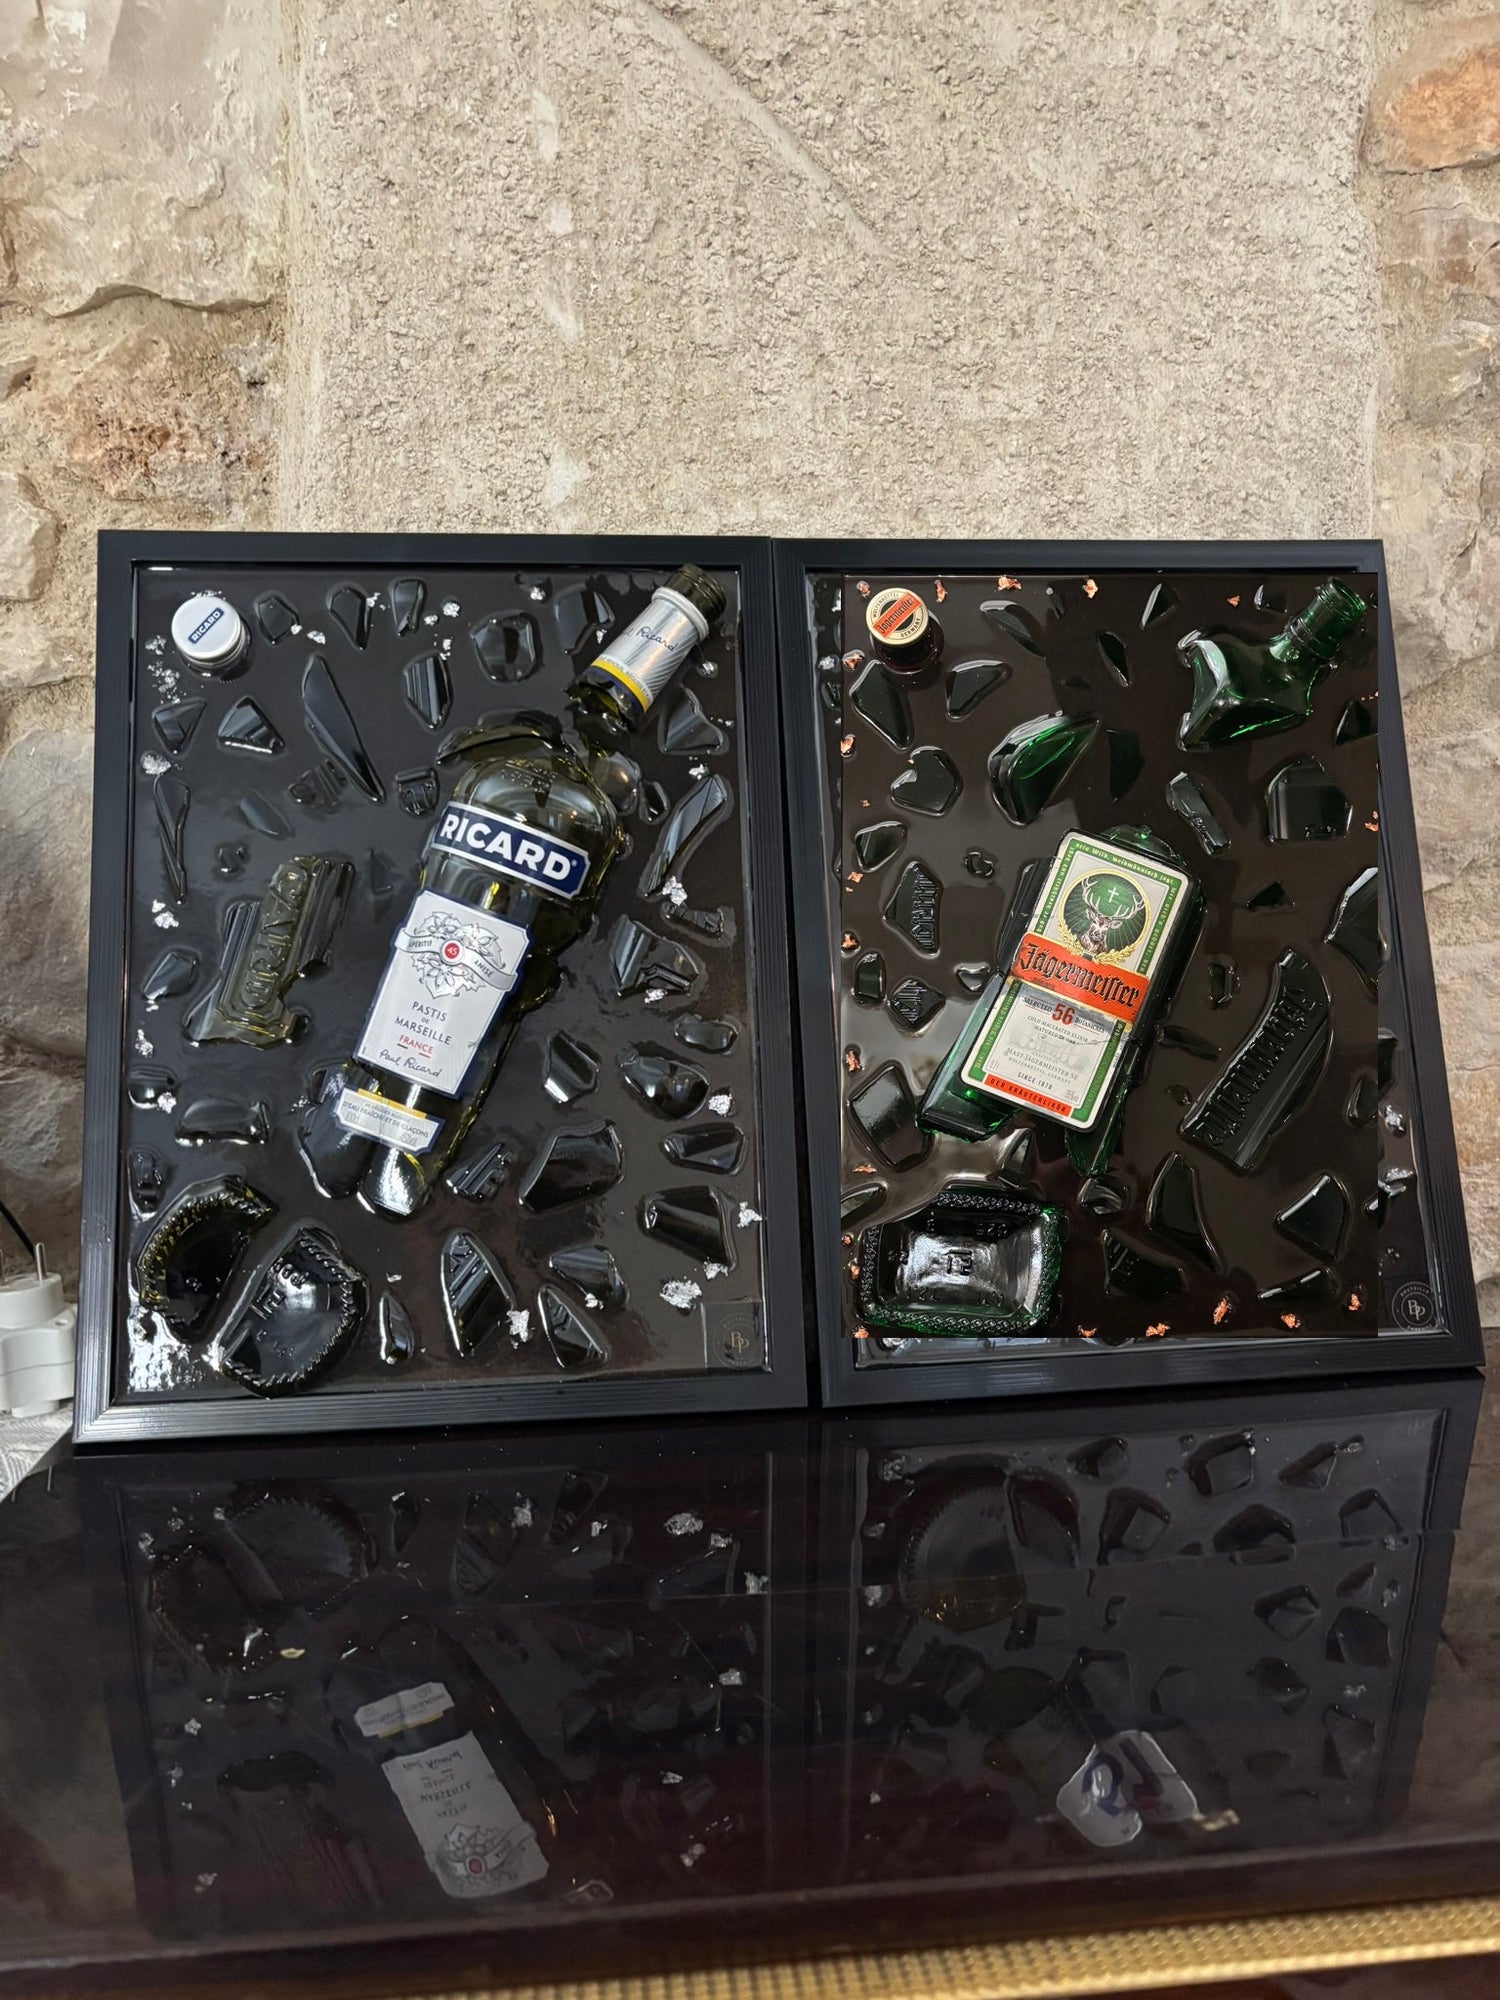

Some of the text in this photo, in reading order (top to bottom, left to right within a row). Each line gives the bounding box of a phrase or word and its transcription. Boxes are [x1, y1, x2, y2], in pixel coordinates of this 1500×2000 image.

[191, 610, 221, 642] RICARD
[636, 625, 680, 652] Ricard
[412, 1001, 447, 1022] PASTIS
[421, 1017, 429, 1025] DE
[1051, 1002, 1076, 1026] 56
[395, 1016, 452, 1045] MARSEILLE
[399, 1035, 434, 1055] FRANCE
[379, 1049, 443, 1078] Paul Ricard
[1017, 1071, 1035, 1083] SINCE
[990, 1078, 1005, 1089] DER
[1008, 1085, 1067, 1112] KRÄUTERLIKÖR
